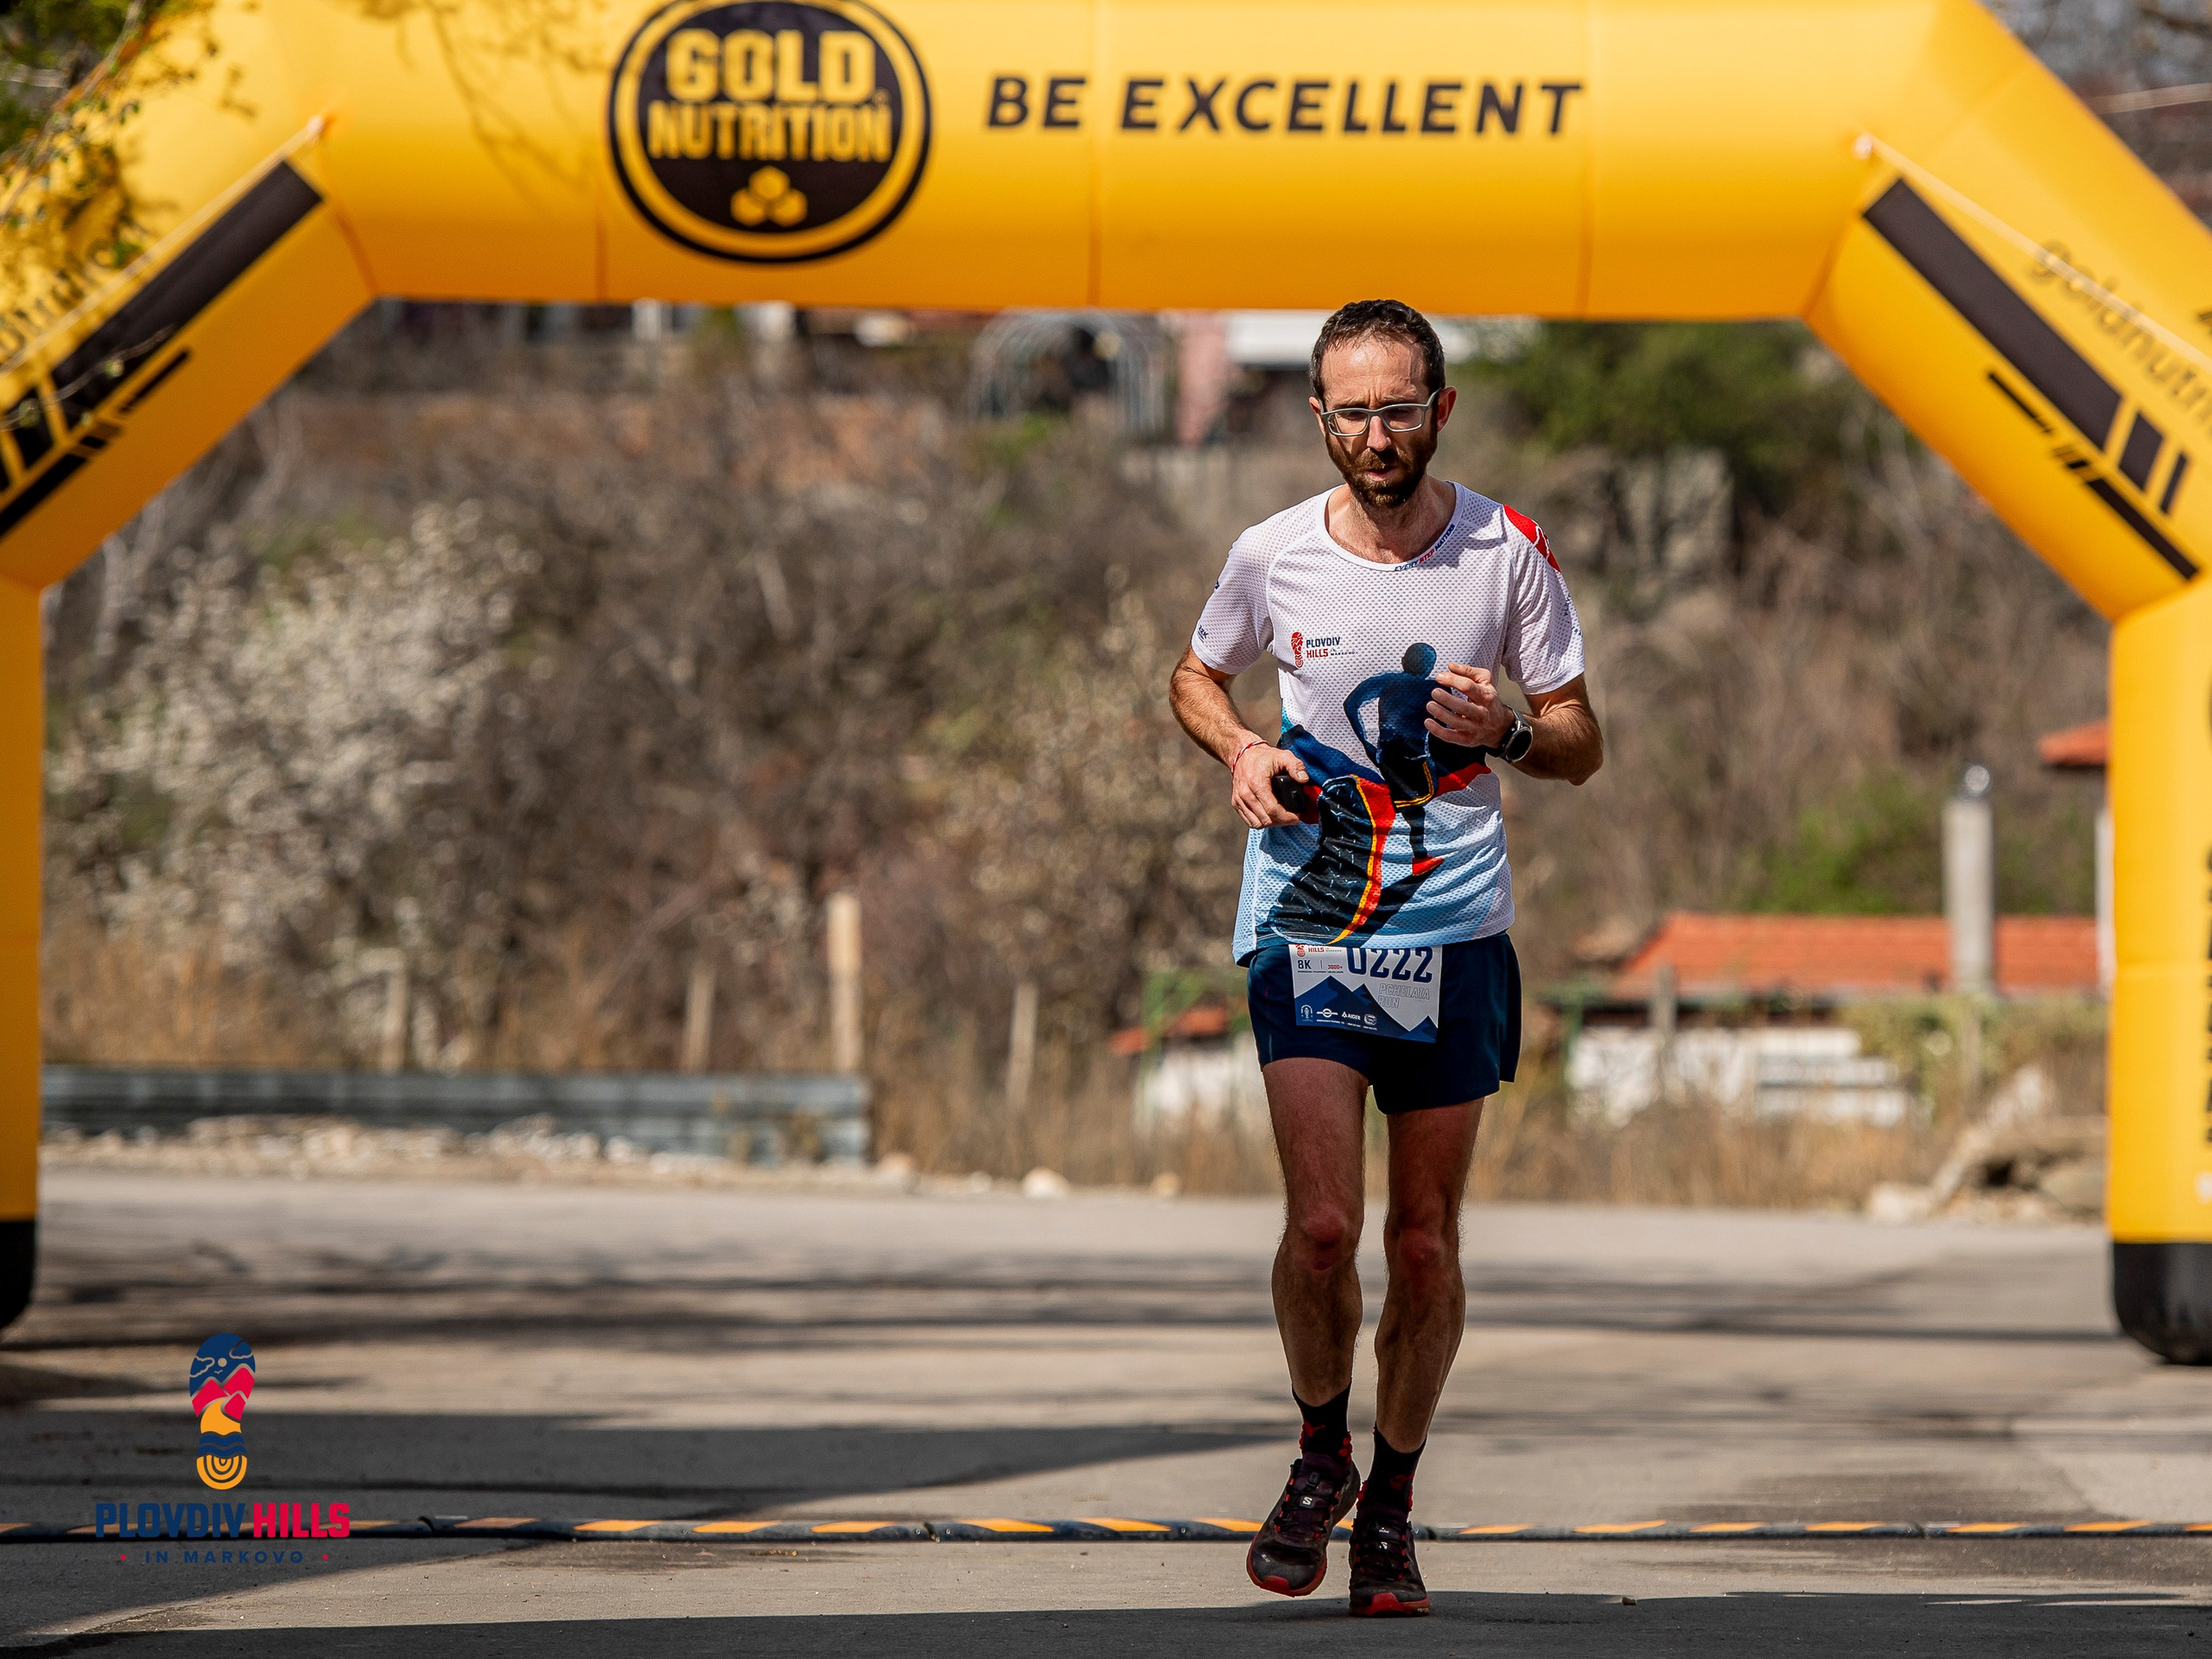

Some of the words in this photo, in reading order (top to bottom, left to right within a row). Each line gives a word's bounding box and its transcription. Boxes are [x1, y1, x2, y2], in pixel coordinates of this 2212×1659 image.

[665, 28, 876, 104] GOLD
[987, 76, 1088, 130] BE
[1120, 77, 1583, 136] EXCELLENT
[647, 99, 893, 162] NUTRITION
[1419, 549, 1435, 563] STEP
[1306, 636, 1341, 648] PLOVDIV
[1306, 648, 1329, 658] HILLS
[1298, 960, 1312, 969] 8K
[1347, 946, 1433, 982] 0222
[1379, 983, 1430, 1000] PCHELATA
[1378, 995, 1400, 1008] RUN
